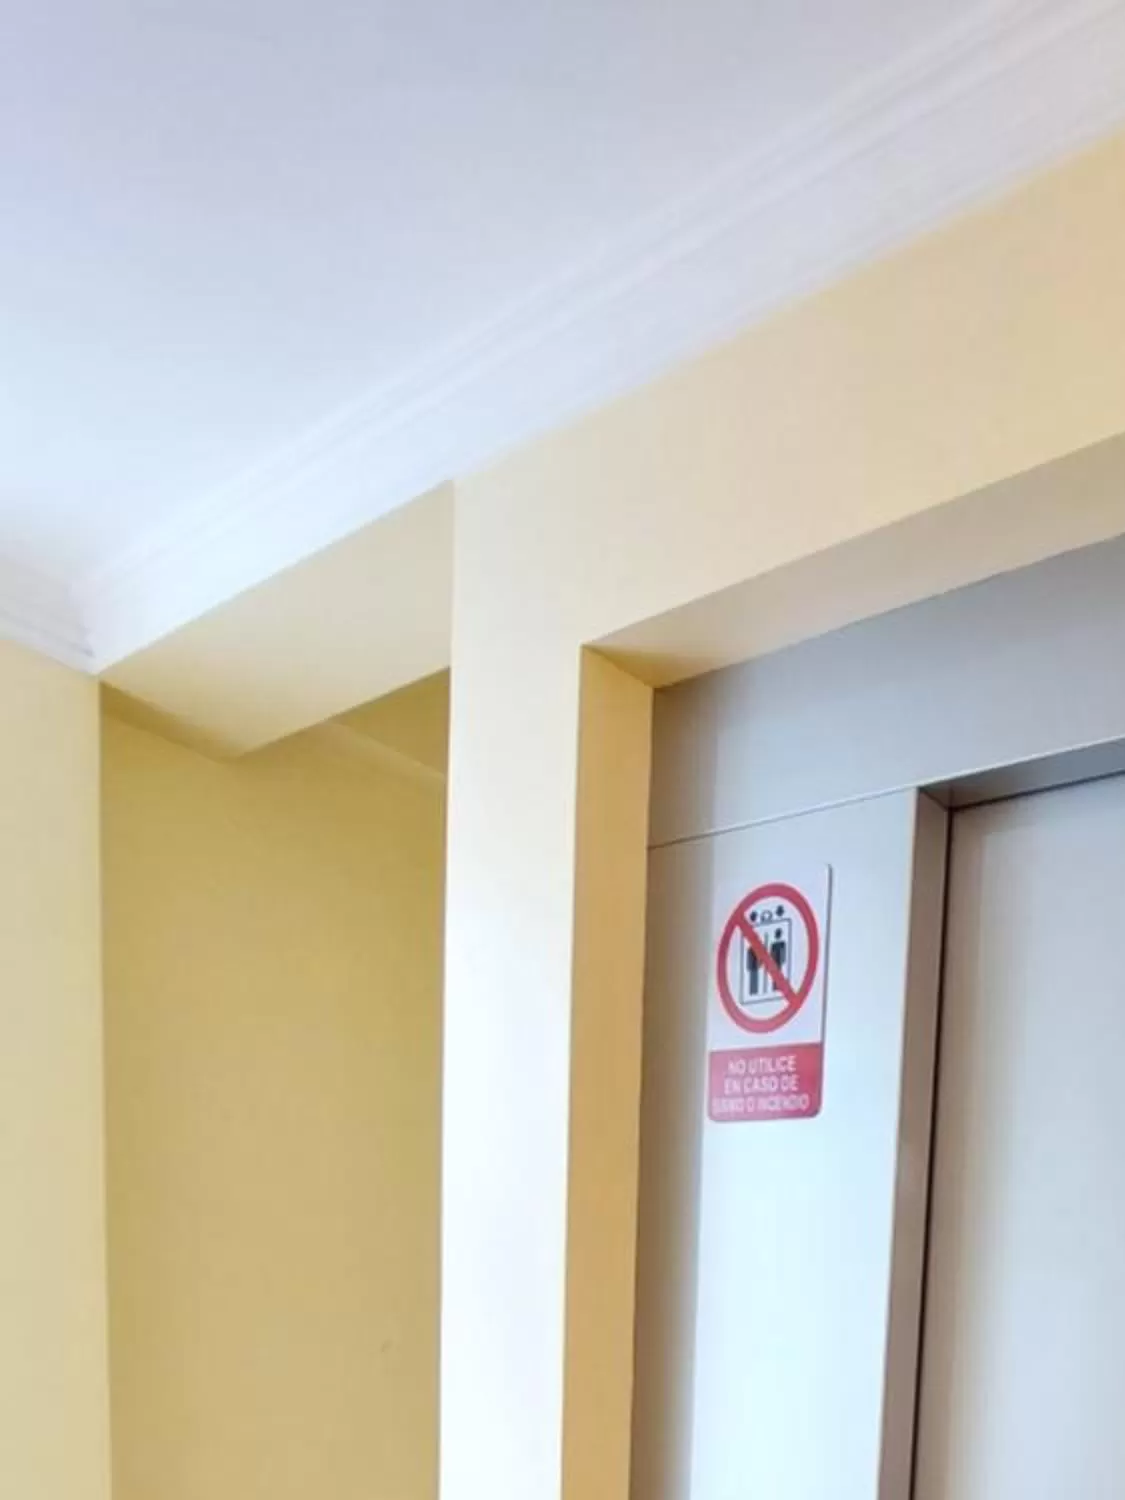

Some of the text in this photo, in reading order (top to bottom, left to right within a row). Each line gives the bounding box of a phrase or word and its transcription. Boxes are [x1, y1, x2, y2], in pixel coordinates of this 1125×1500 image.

[728, 1055, 797, 1075] NO UTILICE
[724, 1073, 800, 1095] EN CASO DE
